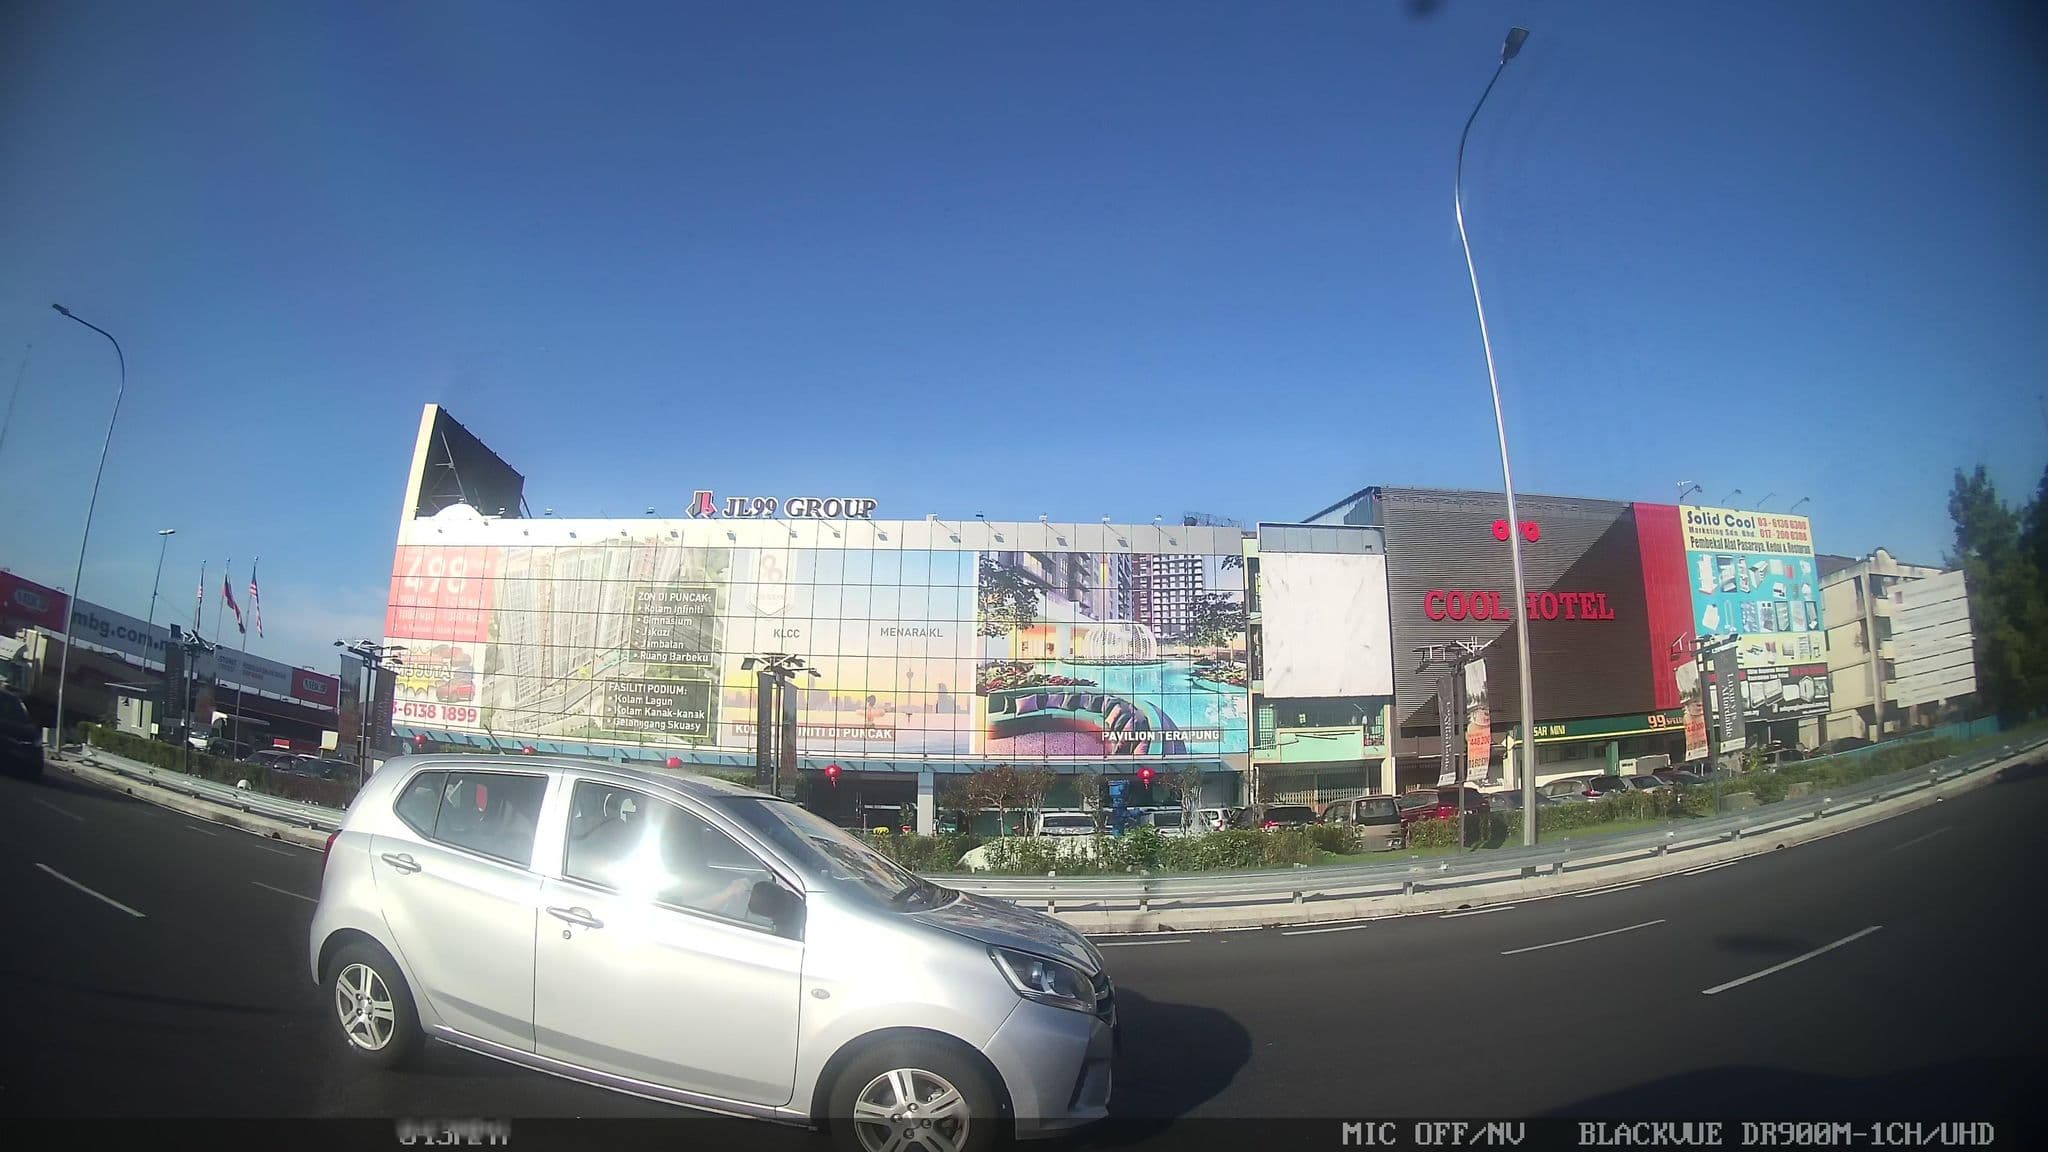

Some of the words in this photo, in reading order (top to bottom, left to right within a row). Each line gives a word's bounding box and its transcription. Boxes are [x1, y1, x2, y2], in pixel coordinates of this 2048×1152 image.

[723, 497, 778, 518] JL99
[785, 497, 877, 519] GROUP
[1687, 510, 1720, 525] Solid
[1724, 514, 1756, 529] Cool
[1491, 519, 1541, 542] OO
[638, 592, 656, 601] ZON
[659, 592, 667, 601] DI
[670, 593, 711, 602] PUNCAK:
[645, 604, 671, 613] Kolam
[1424, 589, 1511, 620] COOL
[1526, 591, 1616, 621] HOTEL
[643, 616, 692, 626] Gimnasium
[642, 627, 670, 637] Jakuzi
[774, 629, 800, 638] KLCC
[880, 627, 927, 637] MENARA
[929, 628, 943, 638] KL
[641, 651, 667, 662] Ruang
[670, 652, 708, 662] Barbeku
[609, 682, 646, 693] FASILITI
[648, 684, 688, 695] PODIUM:
[614, 694, 643, 704] Kolam
[645, 696, 673, 706] Lagun
[441, 705, 478, 722] 1899
[614, 705, 643, 715] Kolam
[645, 706, 705, 719] Kanak-kanak
[614, 717, 666, 730] Gelanggang
[667, 720, 701, 732] Skuasy
[1648, 714, 1666, 728] 99
[829, 728, 840, 738] DI
[844, 729, 893, 739] PUNCAK
[1101, 731, 1155, 741] PAVILION
[1159, 730, 1220, 741] TERAPUNG
